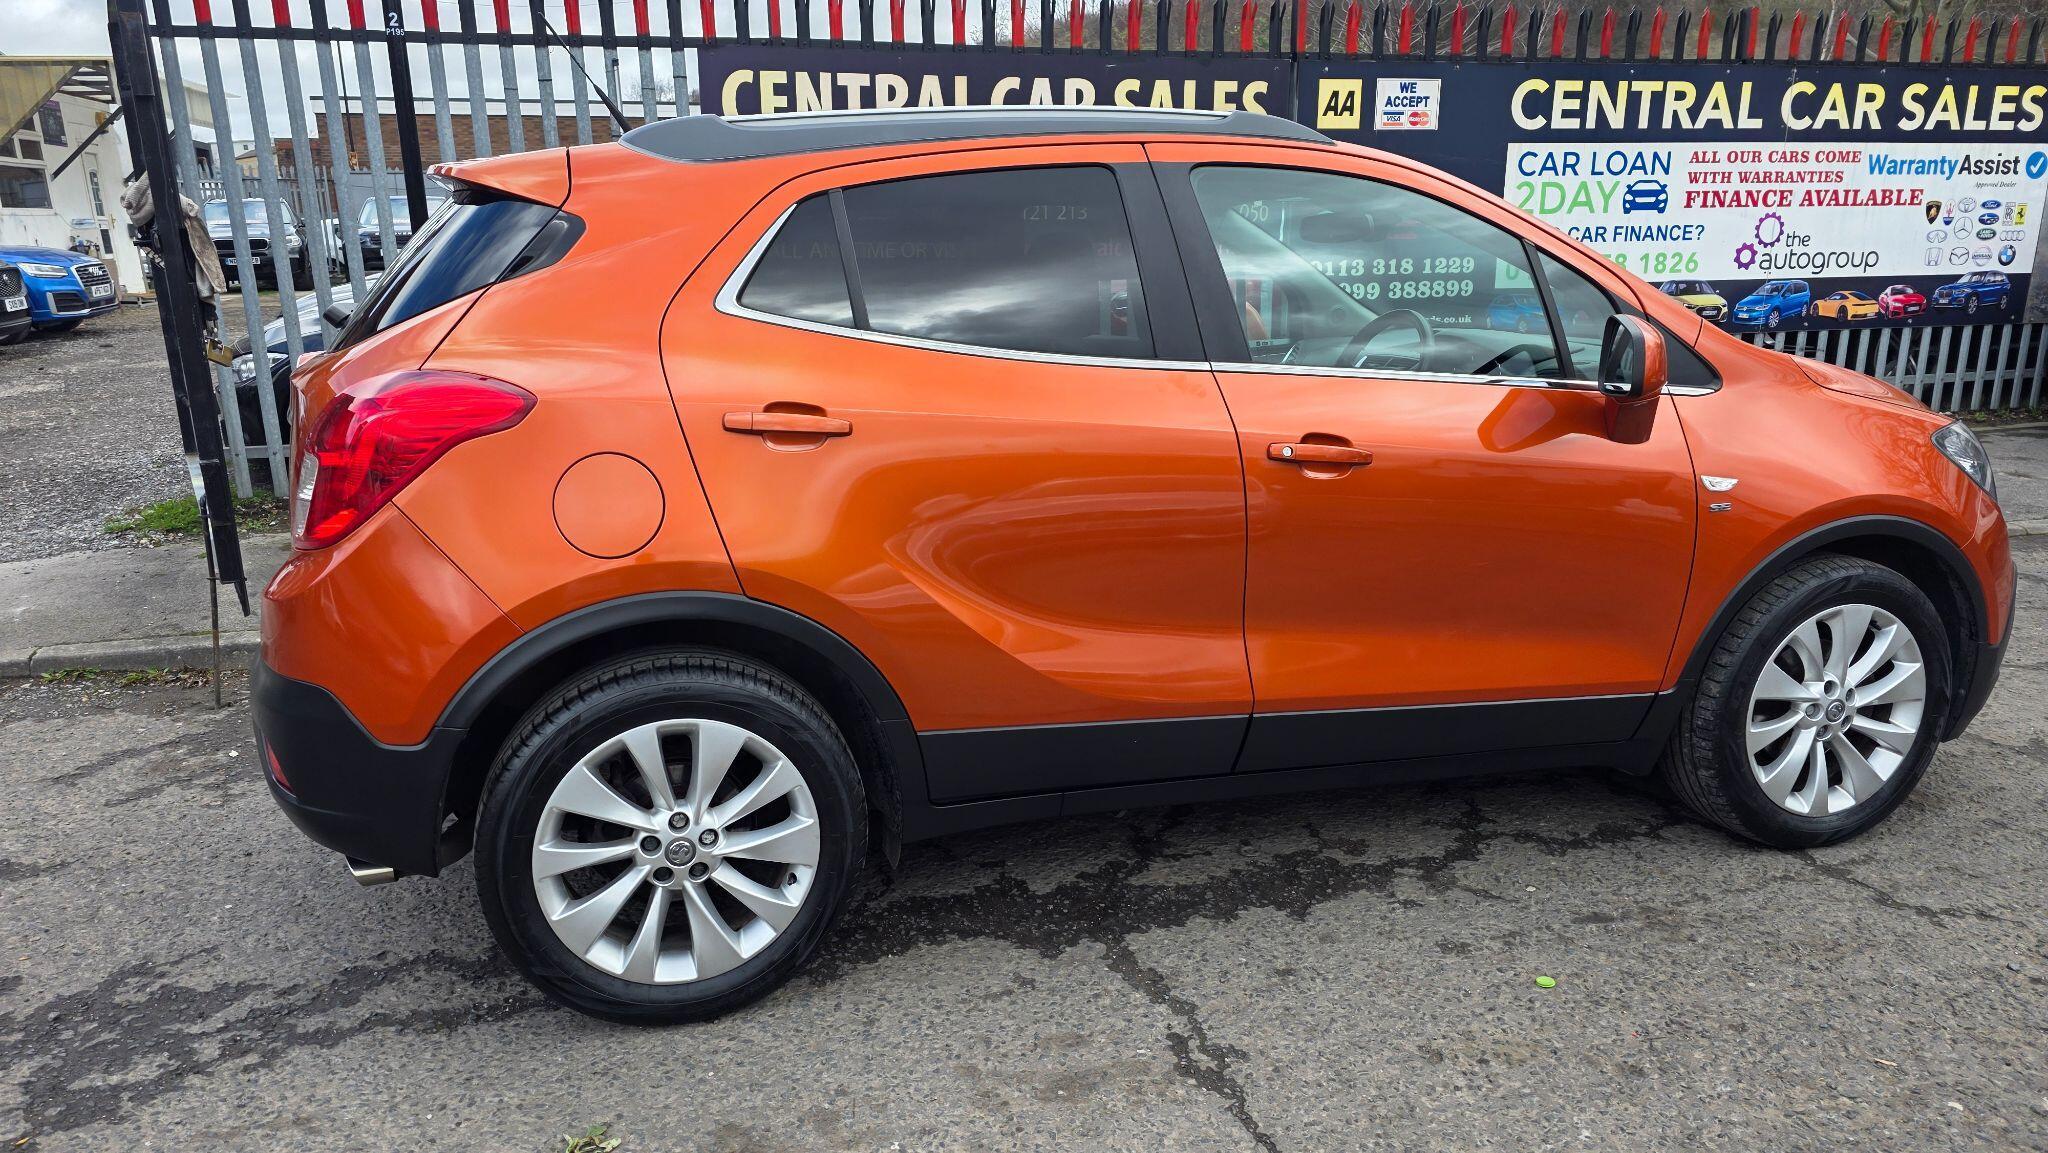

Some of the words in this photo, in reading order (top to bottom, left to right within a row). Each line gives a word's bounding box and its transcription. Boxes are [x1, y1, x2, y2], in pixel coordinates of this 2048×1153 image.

[388, 12, 398, 26] 2
[386, 28, 404, 36] P195
[721, 69, 968, 118] CENTRAL
[1114, 78, 1269, 117] SALES
[1400, 82, 1417, 94] WE
[1322, 90, 1355, 117] AA
[1385, 96, 1430, 108] ACCEPT
[1511, 78, 1763, 130] CENTRAL
[1781, 81, 1886, 130] CAR
[1897, 82, 2047, 132] SALES
[1518, 151, 1580, 176] CAR
[1591, 151, 1672, 176] LOAN
[1689, 151, 1721, 164] ALL
[1727, 151, 1763, 164] OUR
[1768, 150, 1811, 163] CARS
[1815, 150, 1862, 163] COME
[1688, 171, 1733, 184] WITH
[1738, 170, 1844, 184] WARRANTIES
[1516, 180, 1621, 214] 2DAY
[1683, 190, 1793, 208] FINANCE
[1799, 188, 1924, 207] AVAILABLE
[1568, 225, 1608, 242] CAR
[1613, 224, 1705, 243] FINANCE?
[1786, 231, 1811, 247] the
[1372, 258, 1414, 275] 318
[1422, 257, 1475, 274] 1229
[1640, 252, 1699, 274] 1826
[1759, 250, 1880, 274] autogroup
[1388, 280, 1474, 299] 388899
